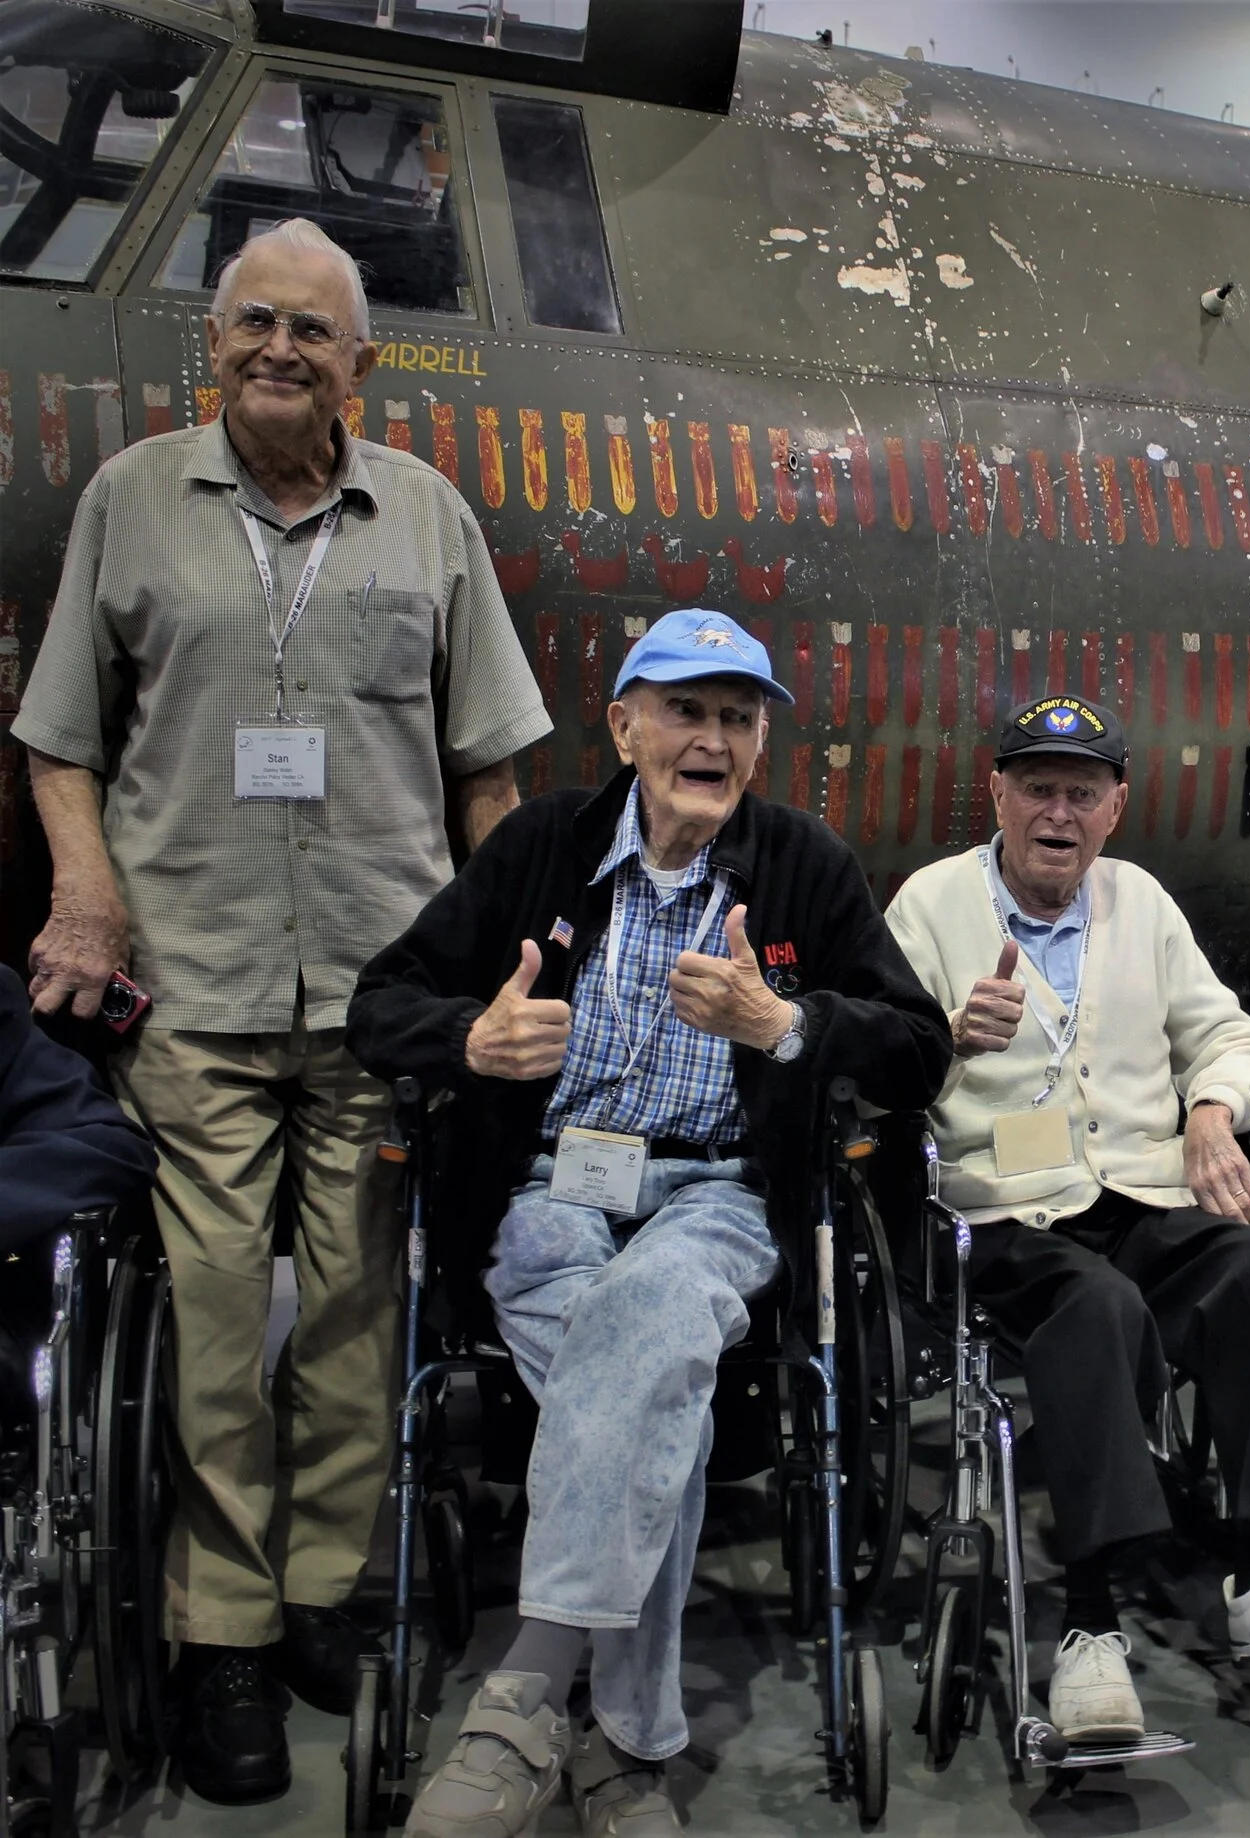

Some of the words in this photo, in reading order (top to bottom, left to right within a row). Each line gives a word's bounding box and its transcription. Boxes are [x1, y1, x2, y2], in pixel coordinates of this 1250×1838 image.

[295, 564, 316, 610] MARAUDER
[1035, 698, 1062, 714] ARMY
[1062, 699, 1080, 710] AIR
[1080, 707, 1105, 732] CORPS
[267, 753, 289, 764] Stan
[613, 907, 623, 926] B-26
[764, 941, 798, 966] USA
[584, 1161, 609, 1176] Larry
